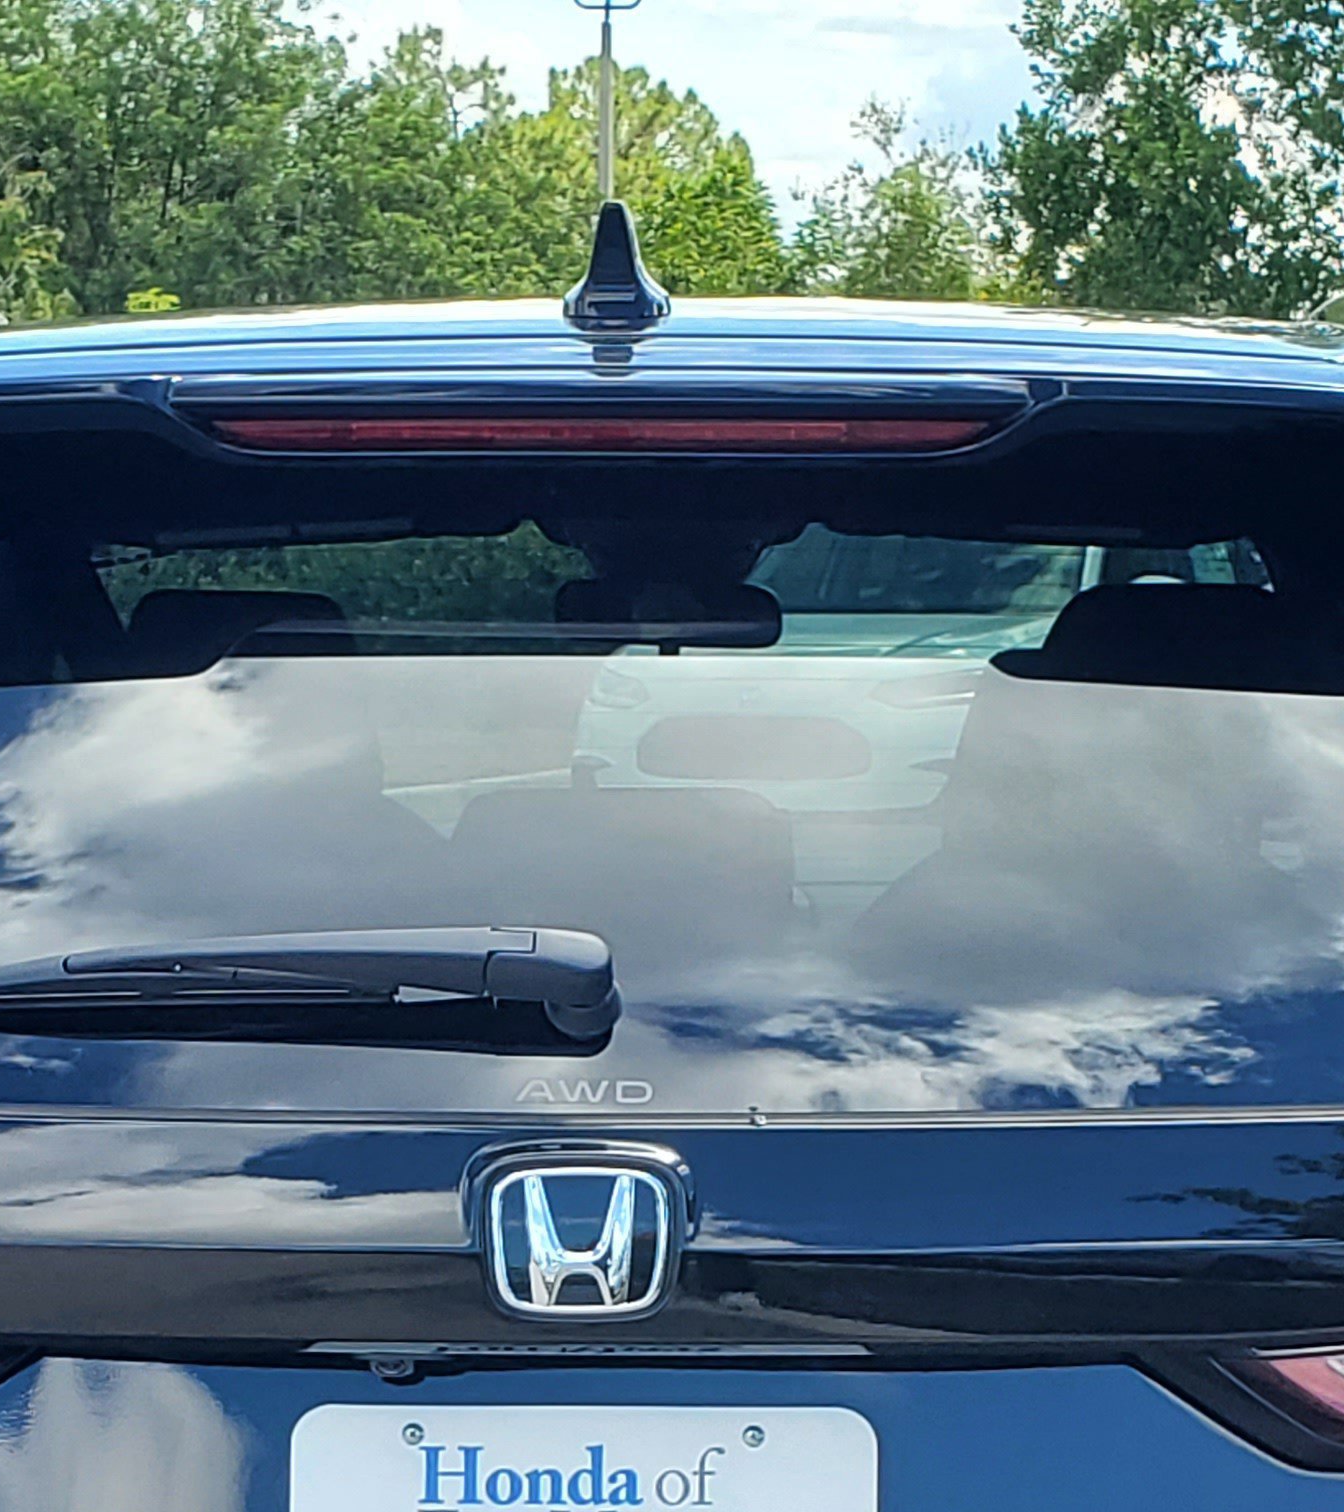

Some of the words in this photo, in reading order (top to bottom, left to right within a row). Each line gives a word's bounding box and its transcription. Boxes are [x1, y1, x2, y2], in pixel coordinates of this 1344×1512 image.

[515, 1079, 654, 1104] AWD
[417, 1443, 644, 1506] Honda
[654, 1446, 726, 1506] of
